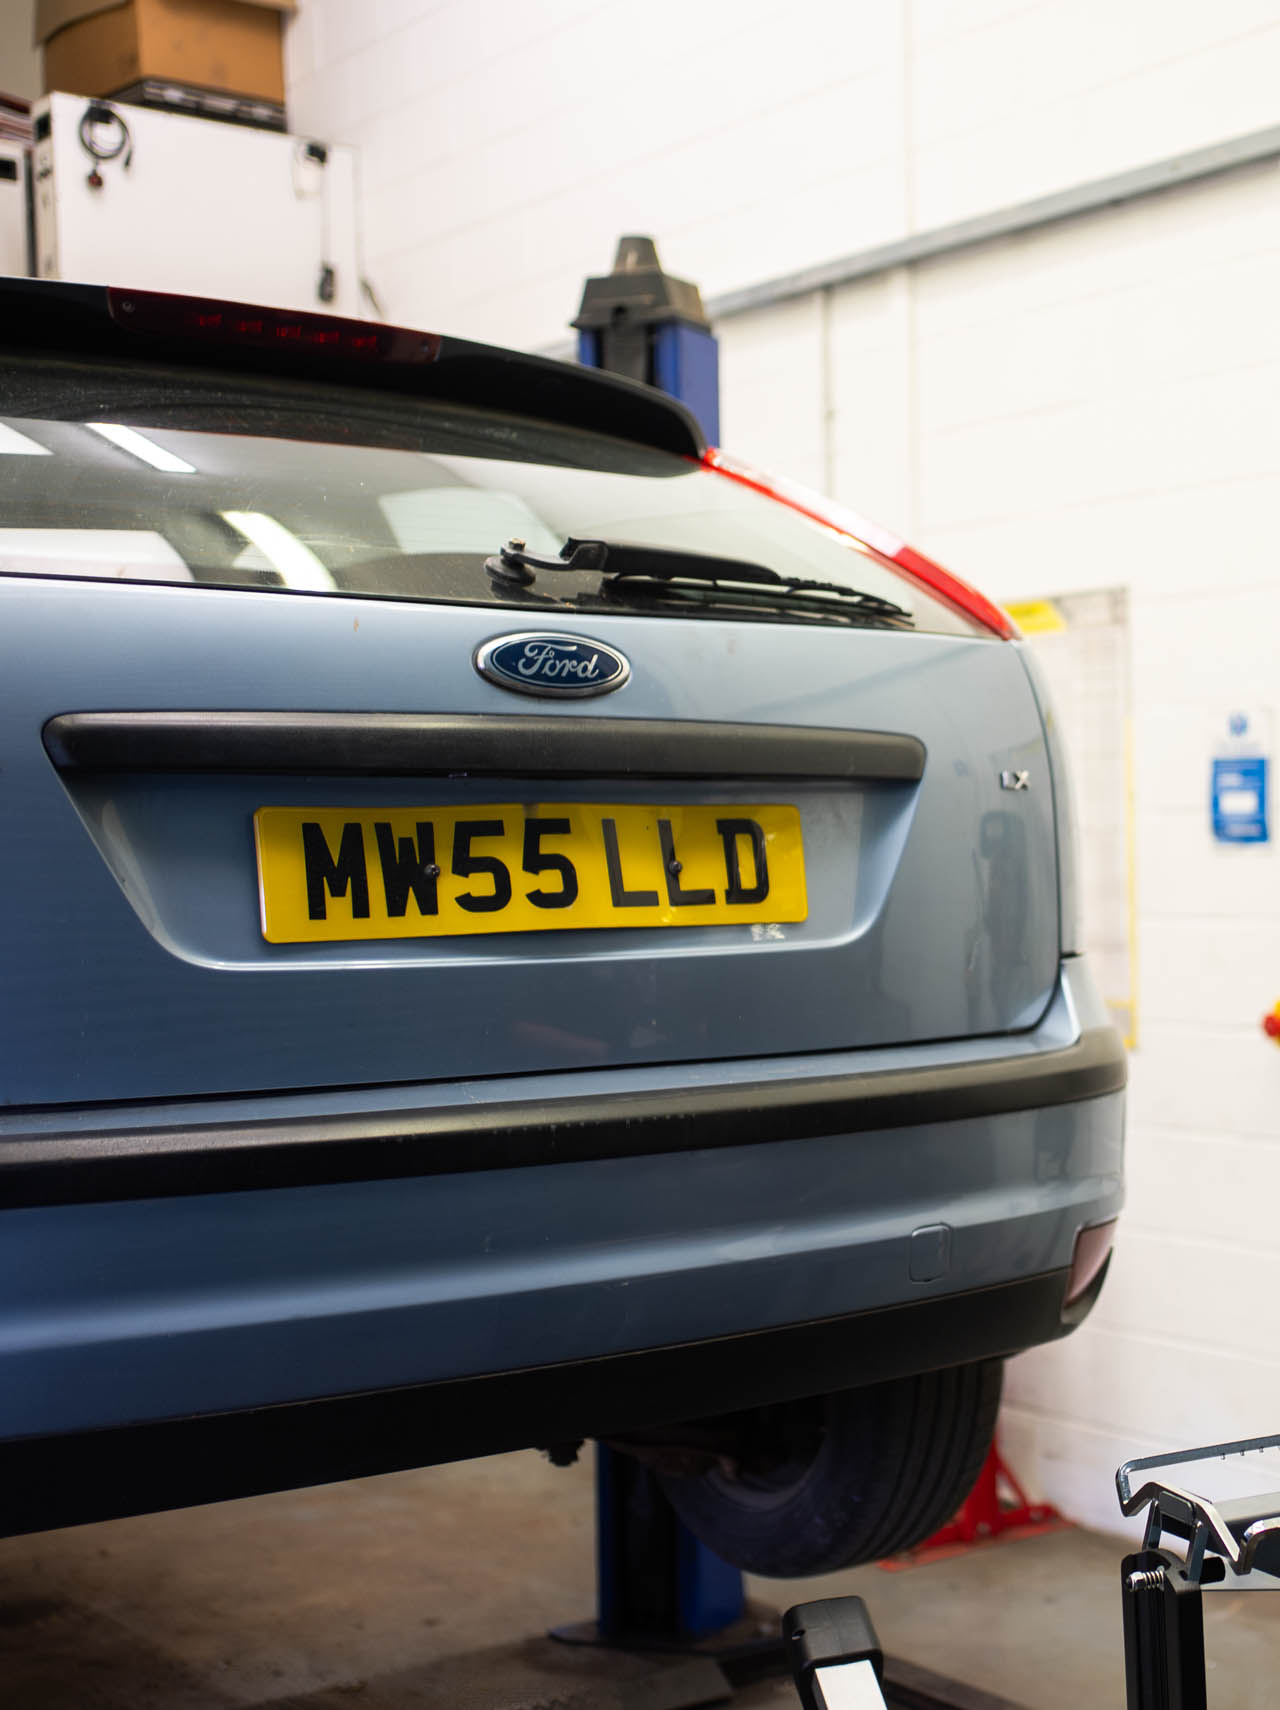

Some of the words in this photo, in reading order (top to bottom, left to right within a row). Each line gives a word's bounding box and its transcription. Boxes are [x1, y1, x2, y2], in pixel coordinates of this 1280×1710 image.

[518, 642, 600, 678] Ford
[1000, 770, 1029, 791] LX
[301, 818, 580, 921] MW55
[601, 817, 771, 908] LLD
